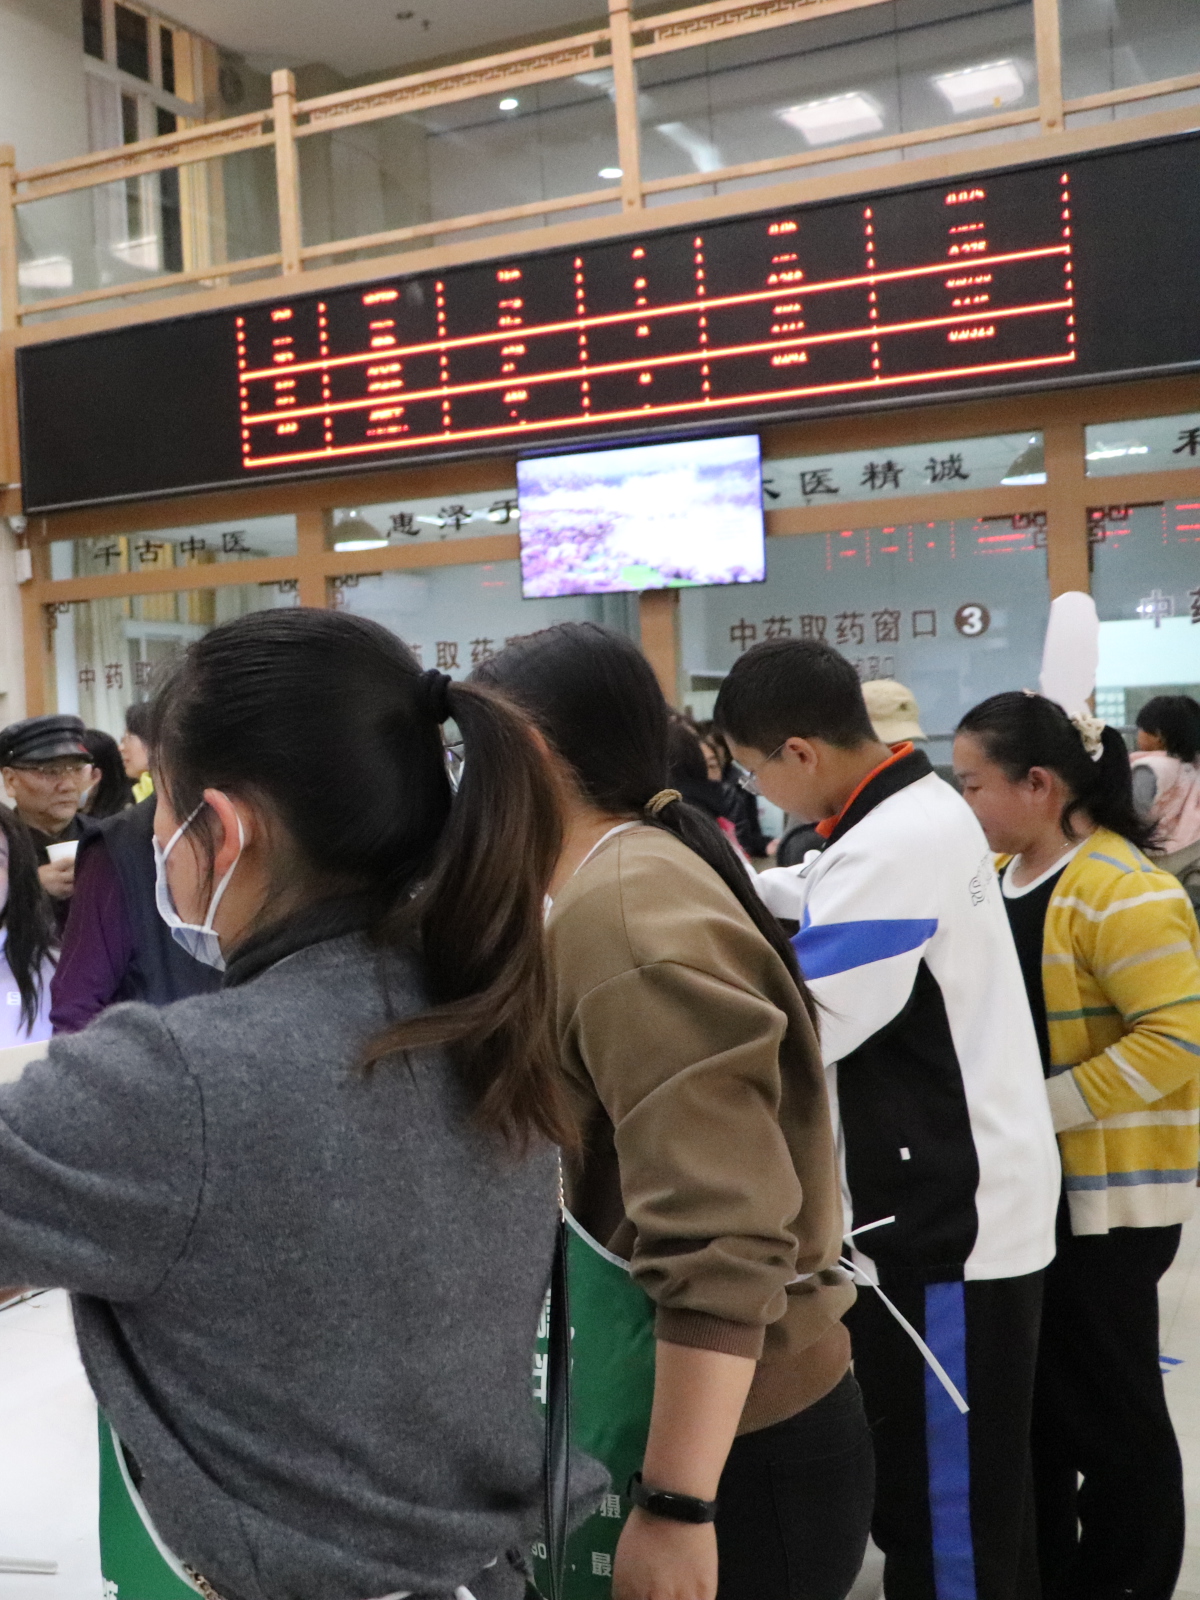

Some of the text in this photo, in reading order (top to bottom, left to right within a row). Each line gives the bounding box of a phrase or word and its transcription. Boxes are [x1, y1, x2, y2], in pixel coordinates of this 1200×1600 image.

[93, 530, 252, 566] 千古中医
[959, 604, 986, 636] 3
